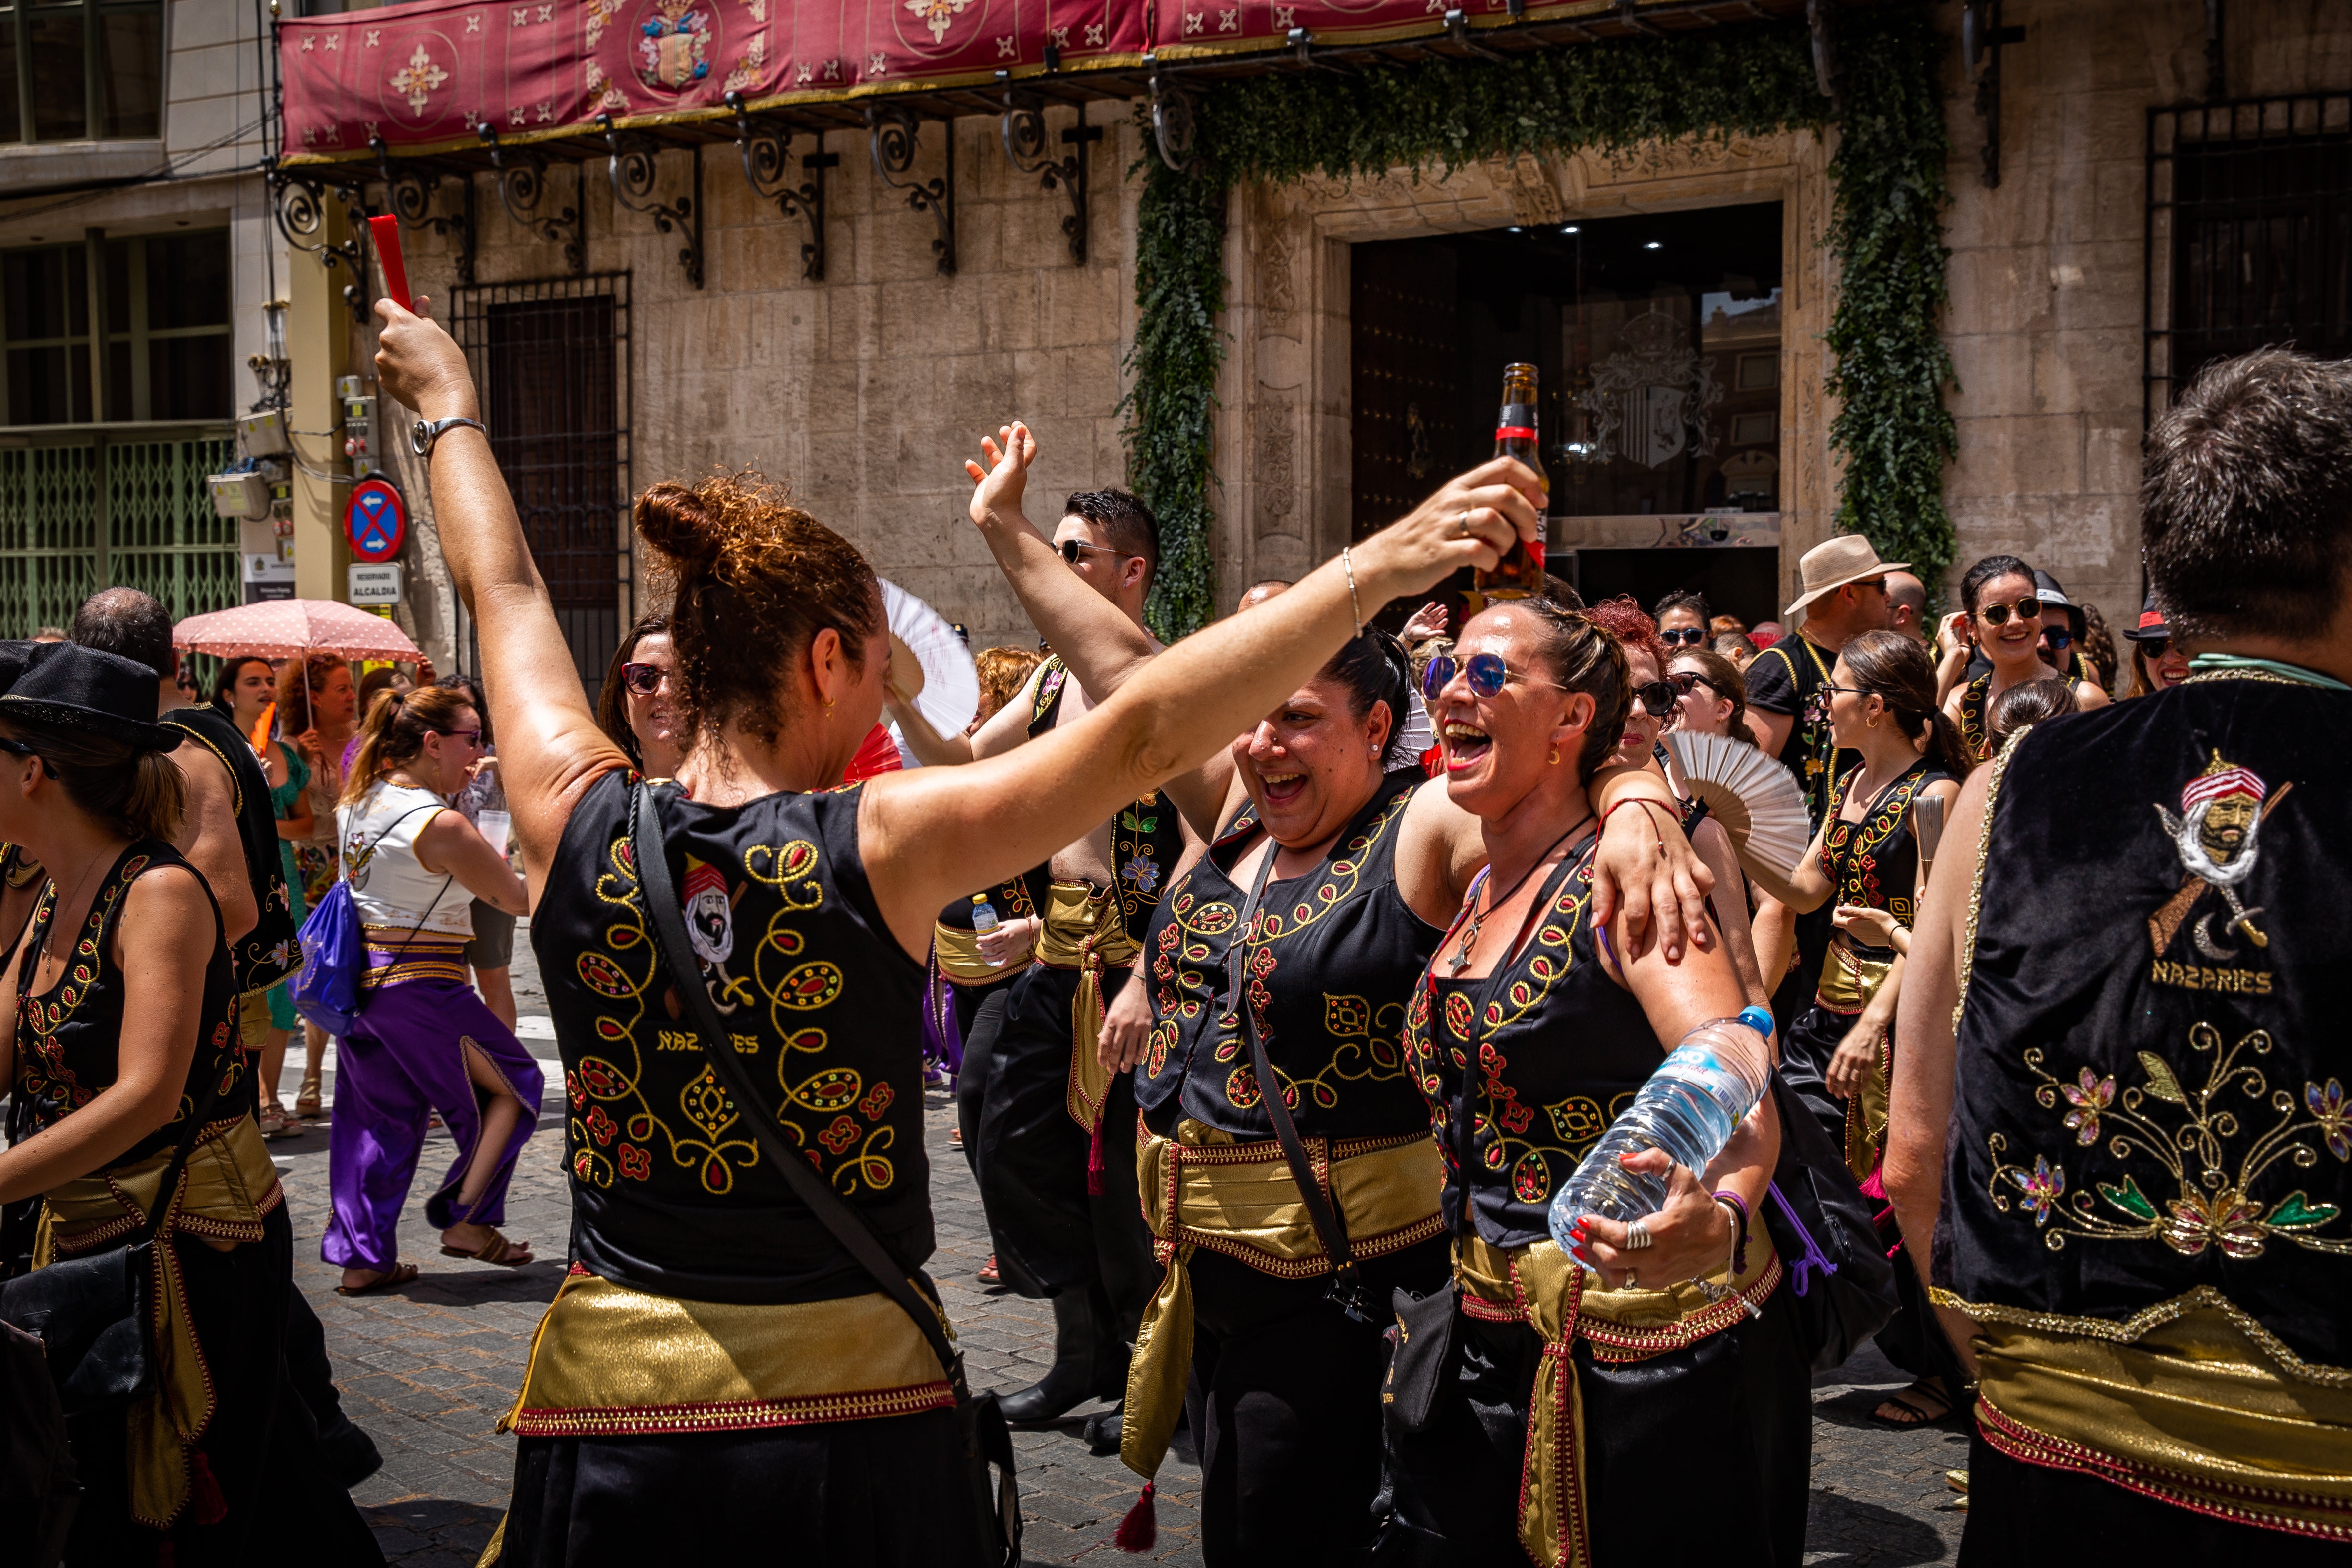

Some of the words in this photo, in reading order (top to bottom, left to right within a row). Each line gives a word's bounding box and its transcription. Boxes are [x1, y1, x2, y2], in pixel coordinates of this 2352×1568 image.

[357, 573, 391, 581] RESERVADO
[2152, 959, 2272, 994] NAZARIES
[656, 1030, 759, 1054] NAZES
